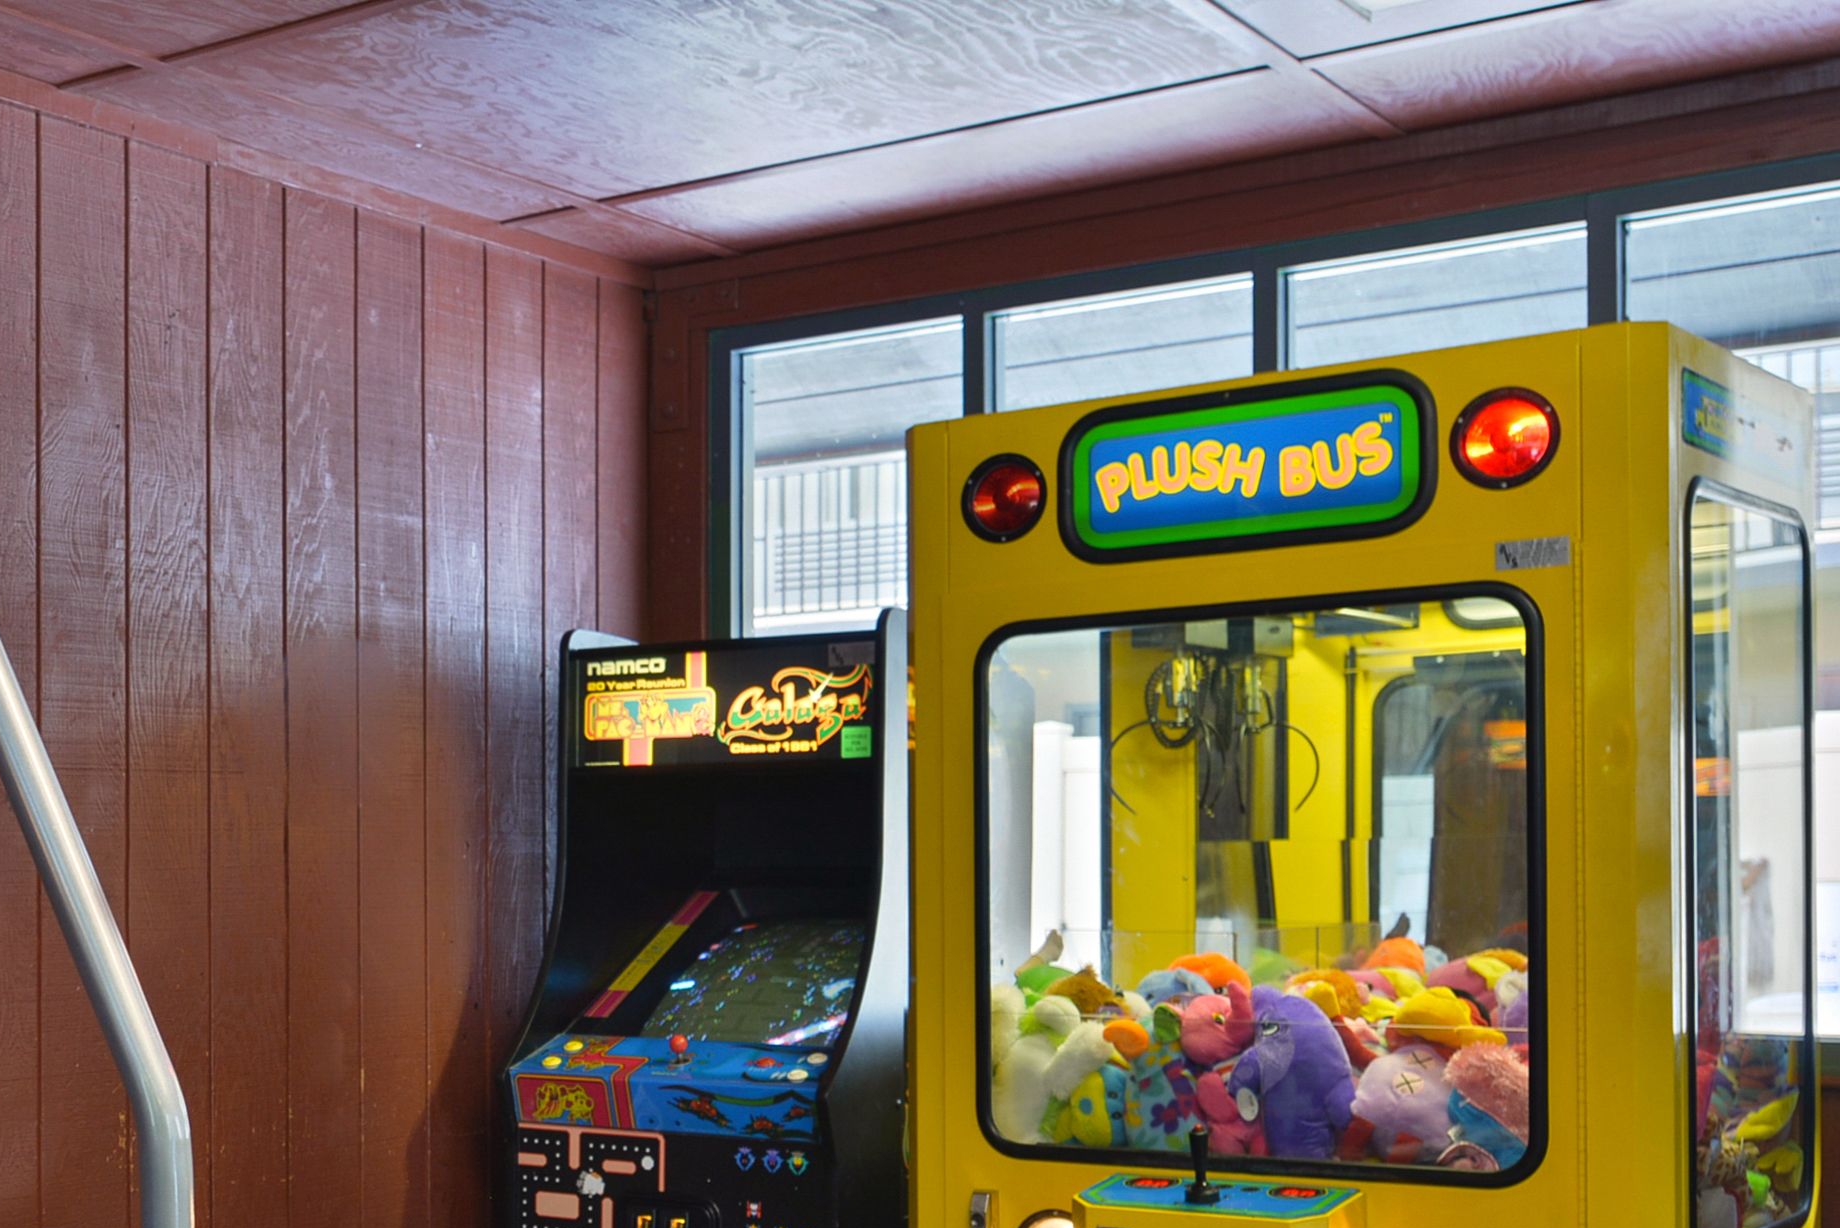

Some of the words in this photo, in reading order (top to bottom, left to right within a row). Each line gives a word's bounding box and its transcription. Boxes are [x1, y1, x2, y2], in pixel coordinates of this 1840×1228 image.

[1095, 439, 1265, 513] PLUSH
[1279, 421, 1393, 497] BUS
[587, 657, 667, 676] namco
[606, 680, 636, 690] Year
[636, 677, 686, 689] Reunion
[727, 682, 866, 746] Galaga
[766, 741, 780, 753] of
